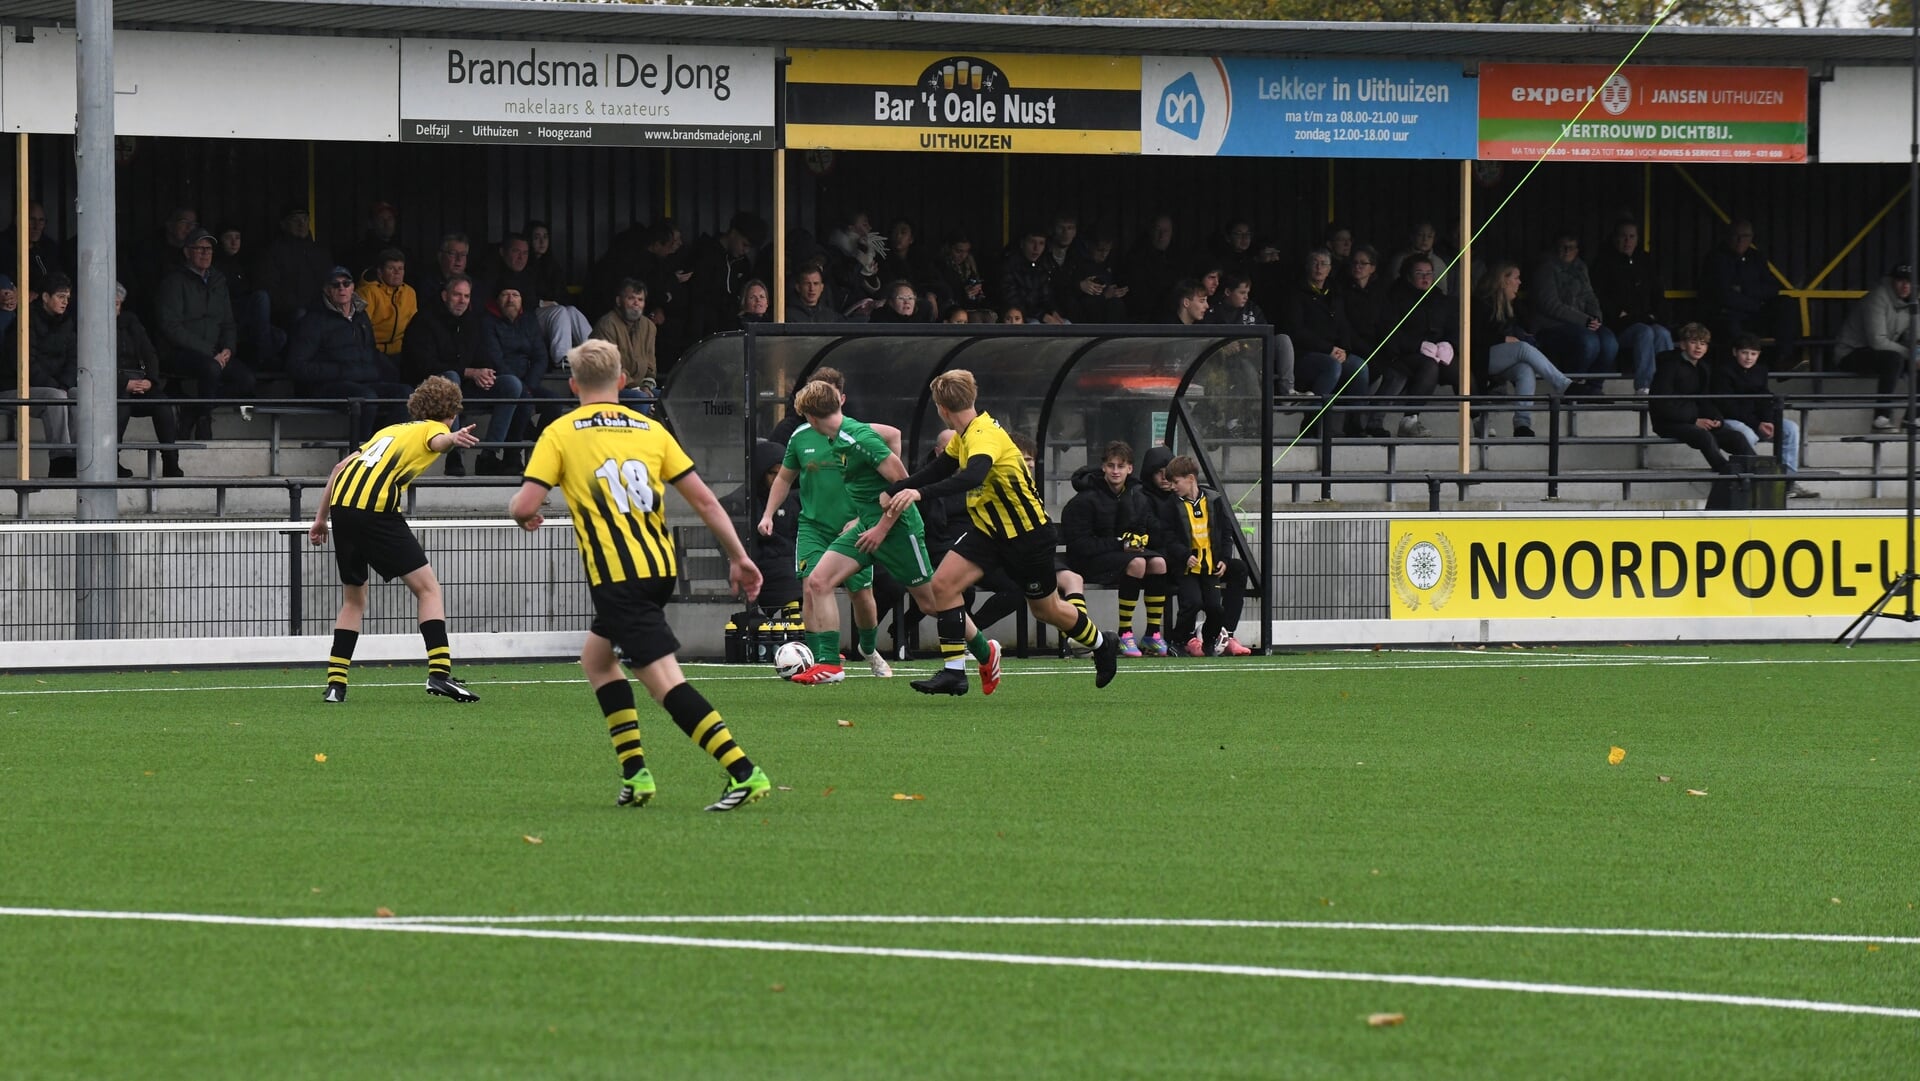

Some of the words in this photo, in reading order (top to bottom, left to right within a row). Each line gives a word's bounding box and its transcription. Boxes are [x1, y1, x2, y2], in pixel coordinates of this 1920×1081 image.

[448, 48, 598, 88] Brandsma
[616, 53, 658, 88] De
[661, 54, 731, 102] Jong
[1258, 76, 1327, 101] Lekker
[1332, 76, 1350, 101] in
[1357, 77, 1449, 103] Uithuizen
[1511, 85, 1595, 106] expert
[1651, 88, 1707, 104] JANSEN
[1711, 91, 1784, 105] UITHUIZEN
[504, 99, 579, 115] makelaars
[585, 100, 595, 115] &
[600, 102, 670, 117] taxateurs
[874, 91, 914, 121] Bar
[921, 92, 937, 122] 't
[943, 92, 996, 123] Oale
[1003, 94, 1056, 124] Nust
[1285, 112, 1301, 123] ma
[1304, 110, 1323, 124] t/m
[1326, 113, 1337, 124] za
[1340, 111, 1399, 124] 08.00-21.00
[1401, 113, 1418, 125] uur
[415, 124, 450, 138] Delfzijl
[472, 125, 519, 138] Uithuizen
[537, 127, 592, 140] Hoogezand
[644, 129, 762, 144] www.brandsmadejong.nl
[919, 133, 1012, 150] UITHUIZEN
[1295, 127, 1331, 143] zondag
[1333, 129, 1390, 142] 12.00-18.00
[1392, 131, 1409, 142] uur
[1561, 124, 1657, 139] VERTROUWD
[1661, 124, 1733, 140] DICHTBIJ.
[703, 401, 732, 416] Thuis
[574, 420, 592, 430] Bar
[357, 436, 395, 468] 4
[594, 457, 654, 514] 18
